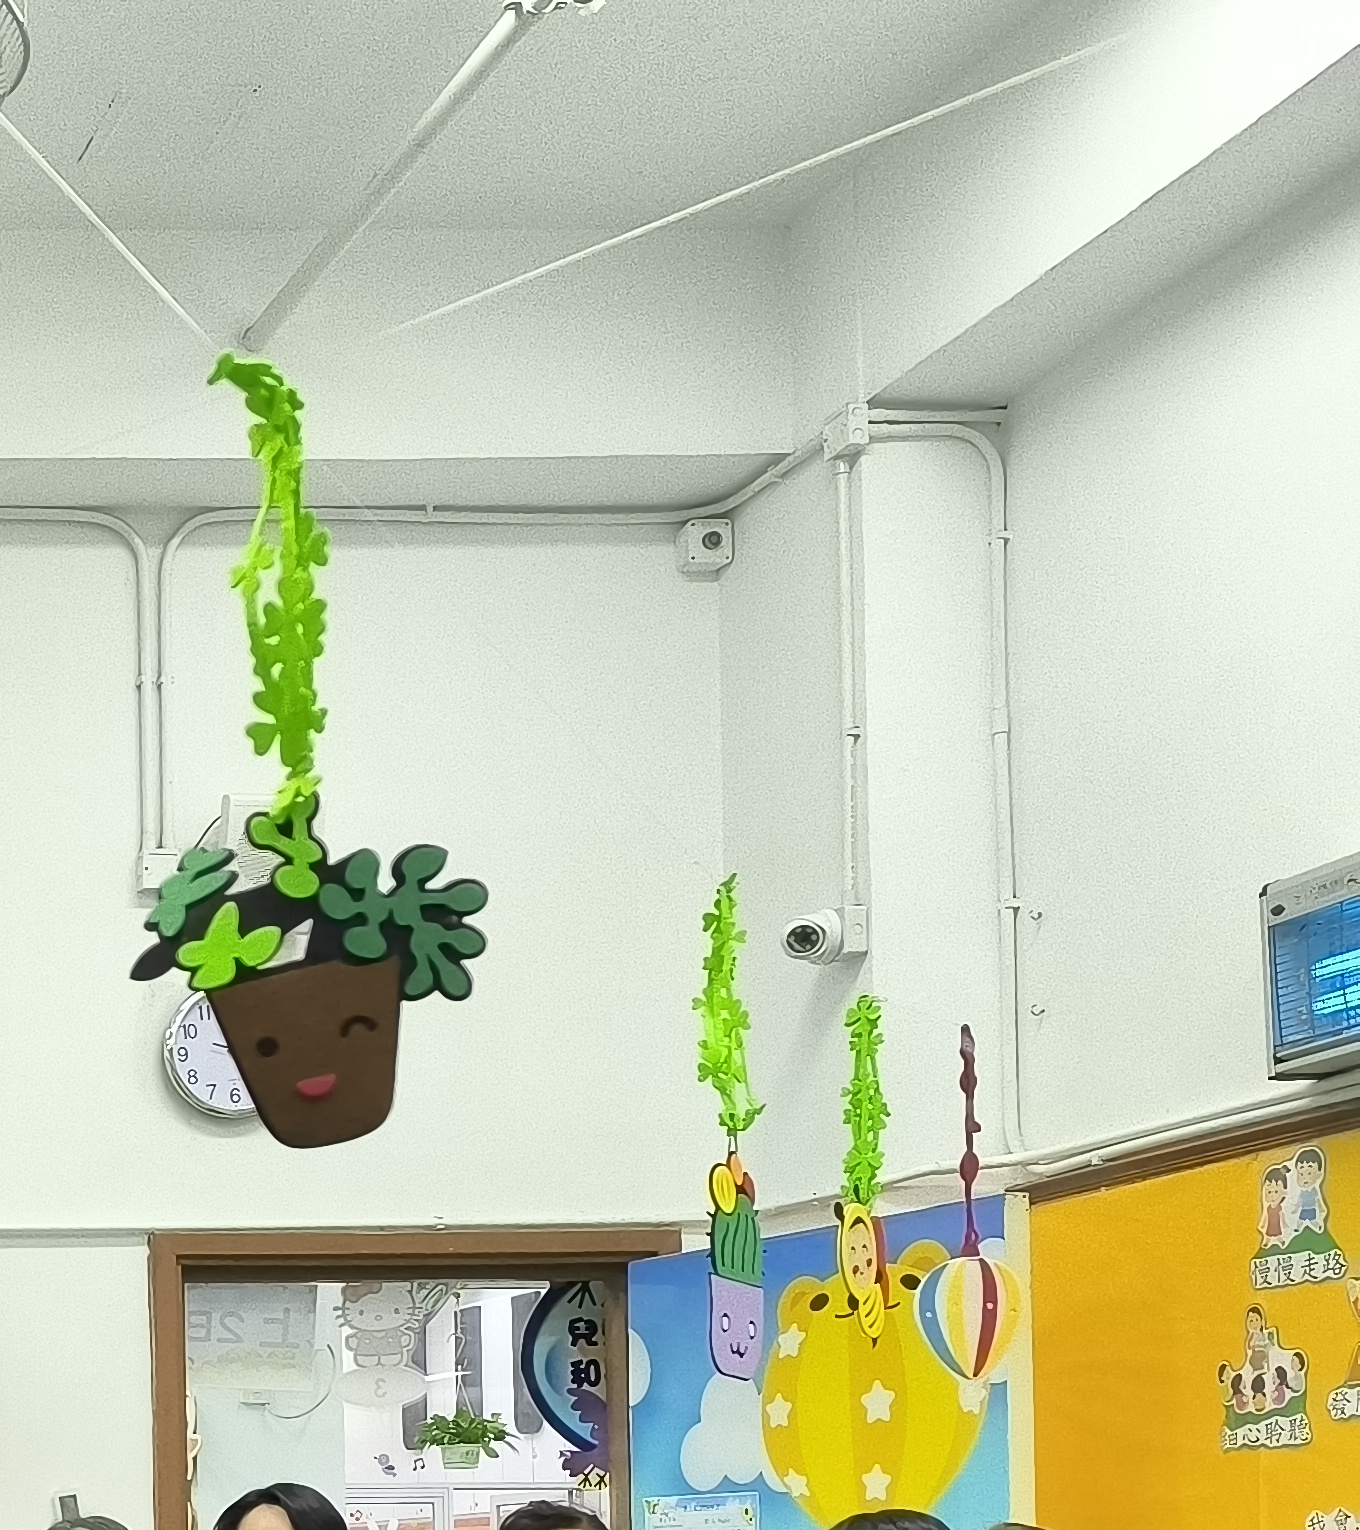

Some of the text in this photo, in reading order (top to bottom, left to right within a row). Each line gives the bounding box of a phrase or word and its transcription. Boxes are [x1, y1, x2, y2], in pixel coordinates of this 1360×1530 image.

[199, 1005, 210, 1020] 11
[181, 1024, 197, 1039] 10
[178, 1047, 188, 1062] 9
[187, 1069, 198, 1084] 8
[206, 1084, 217, 1100] 7
[230, 1088, 241, 1103] 6
[1251, 1251, 1347, 1287] 慢慢走路
[1329, 1389, 1360, 1418] 發
[1221, 1416, 1311, 1447] 細心聆聽
